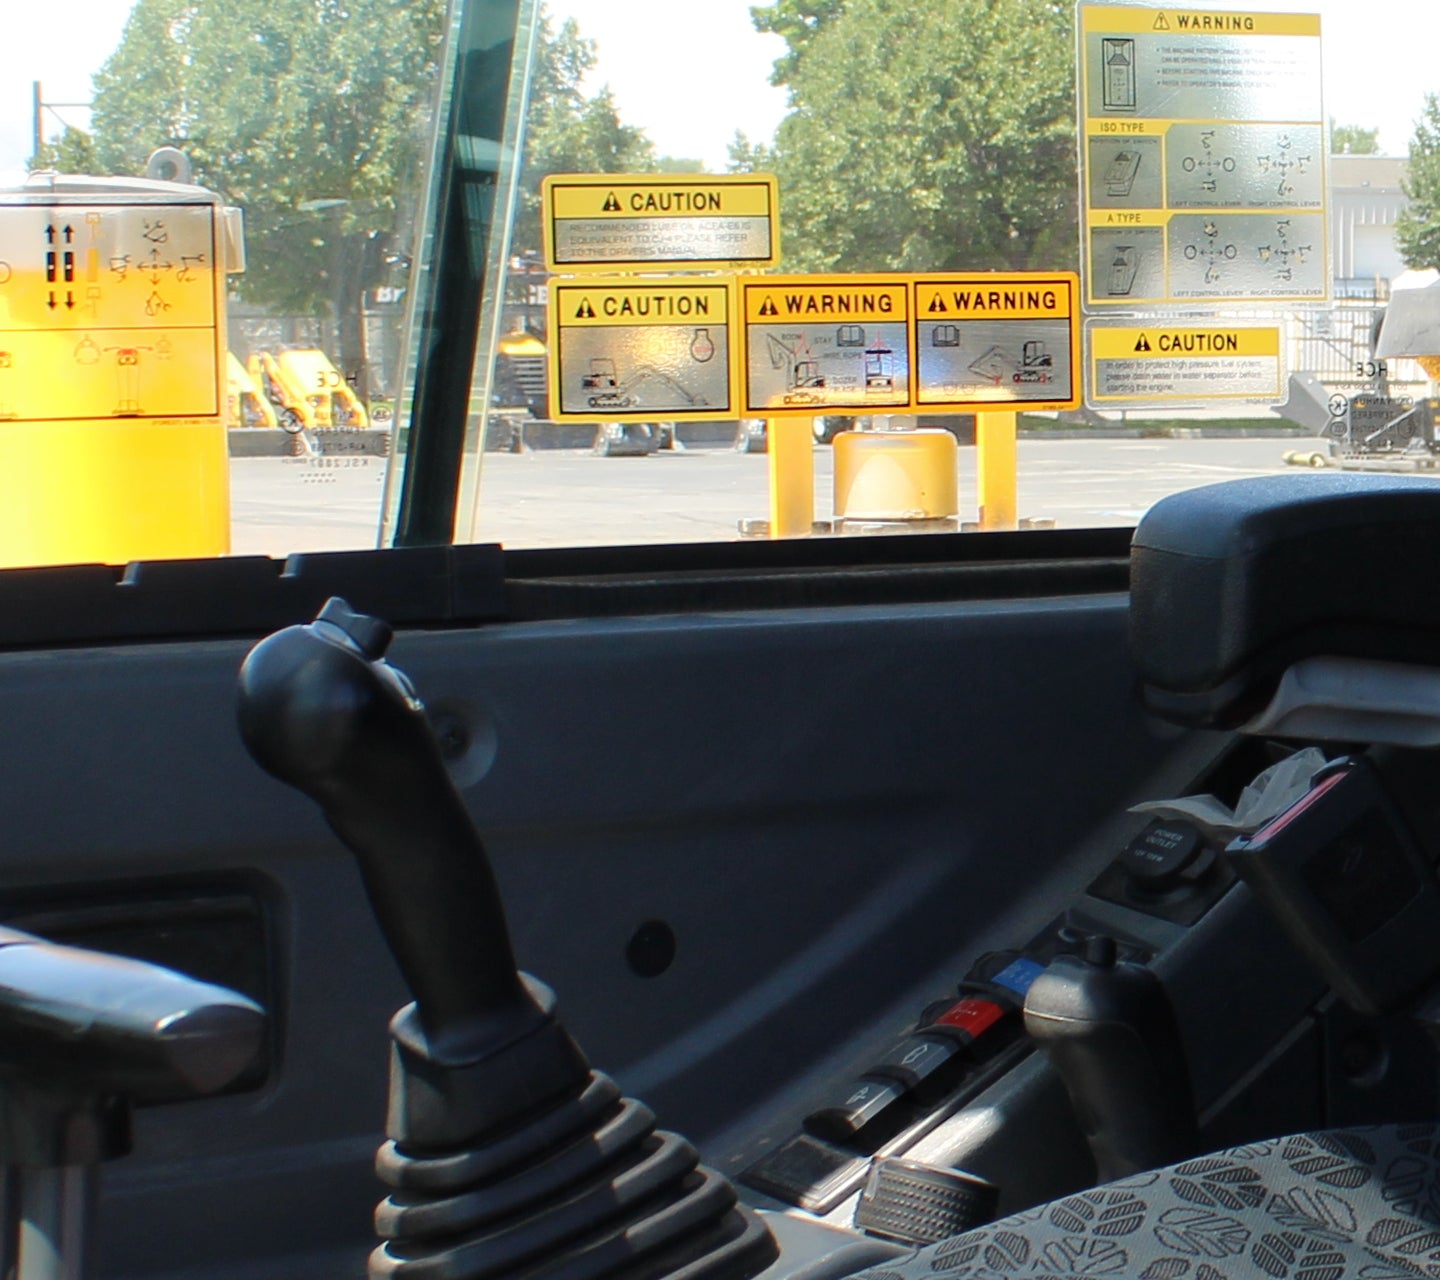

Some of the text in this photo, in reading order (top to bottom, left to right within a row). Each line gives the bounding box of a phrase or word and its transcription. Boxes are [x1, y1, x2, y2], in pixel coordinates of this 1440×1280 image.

[1176, 15, 1254, 31] WARNING
[1100, 122, 1145, 133] ISO TYPE
[630, 192, 721, 211] CAUTION
[1107, 213, 1141, 223] A TYPE
[603, 296, 709, 316] CAUTION
[785, 294, 893, 314] WARNING
[953, 291, 1057, 311] WARNING
[1158, 334, 1238, 352] CAUTION
[1145, 835, 1178, 850] OUTLET
